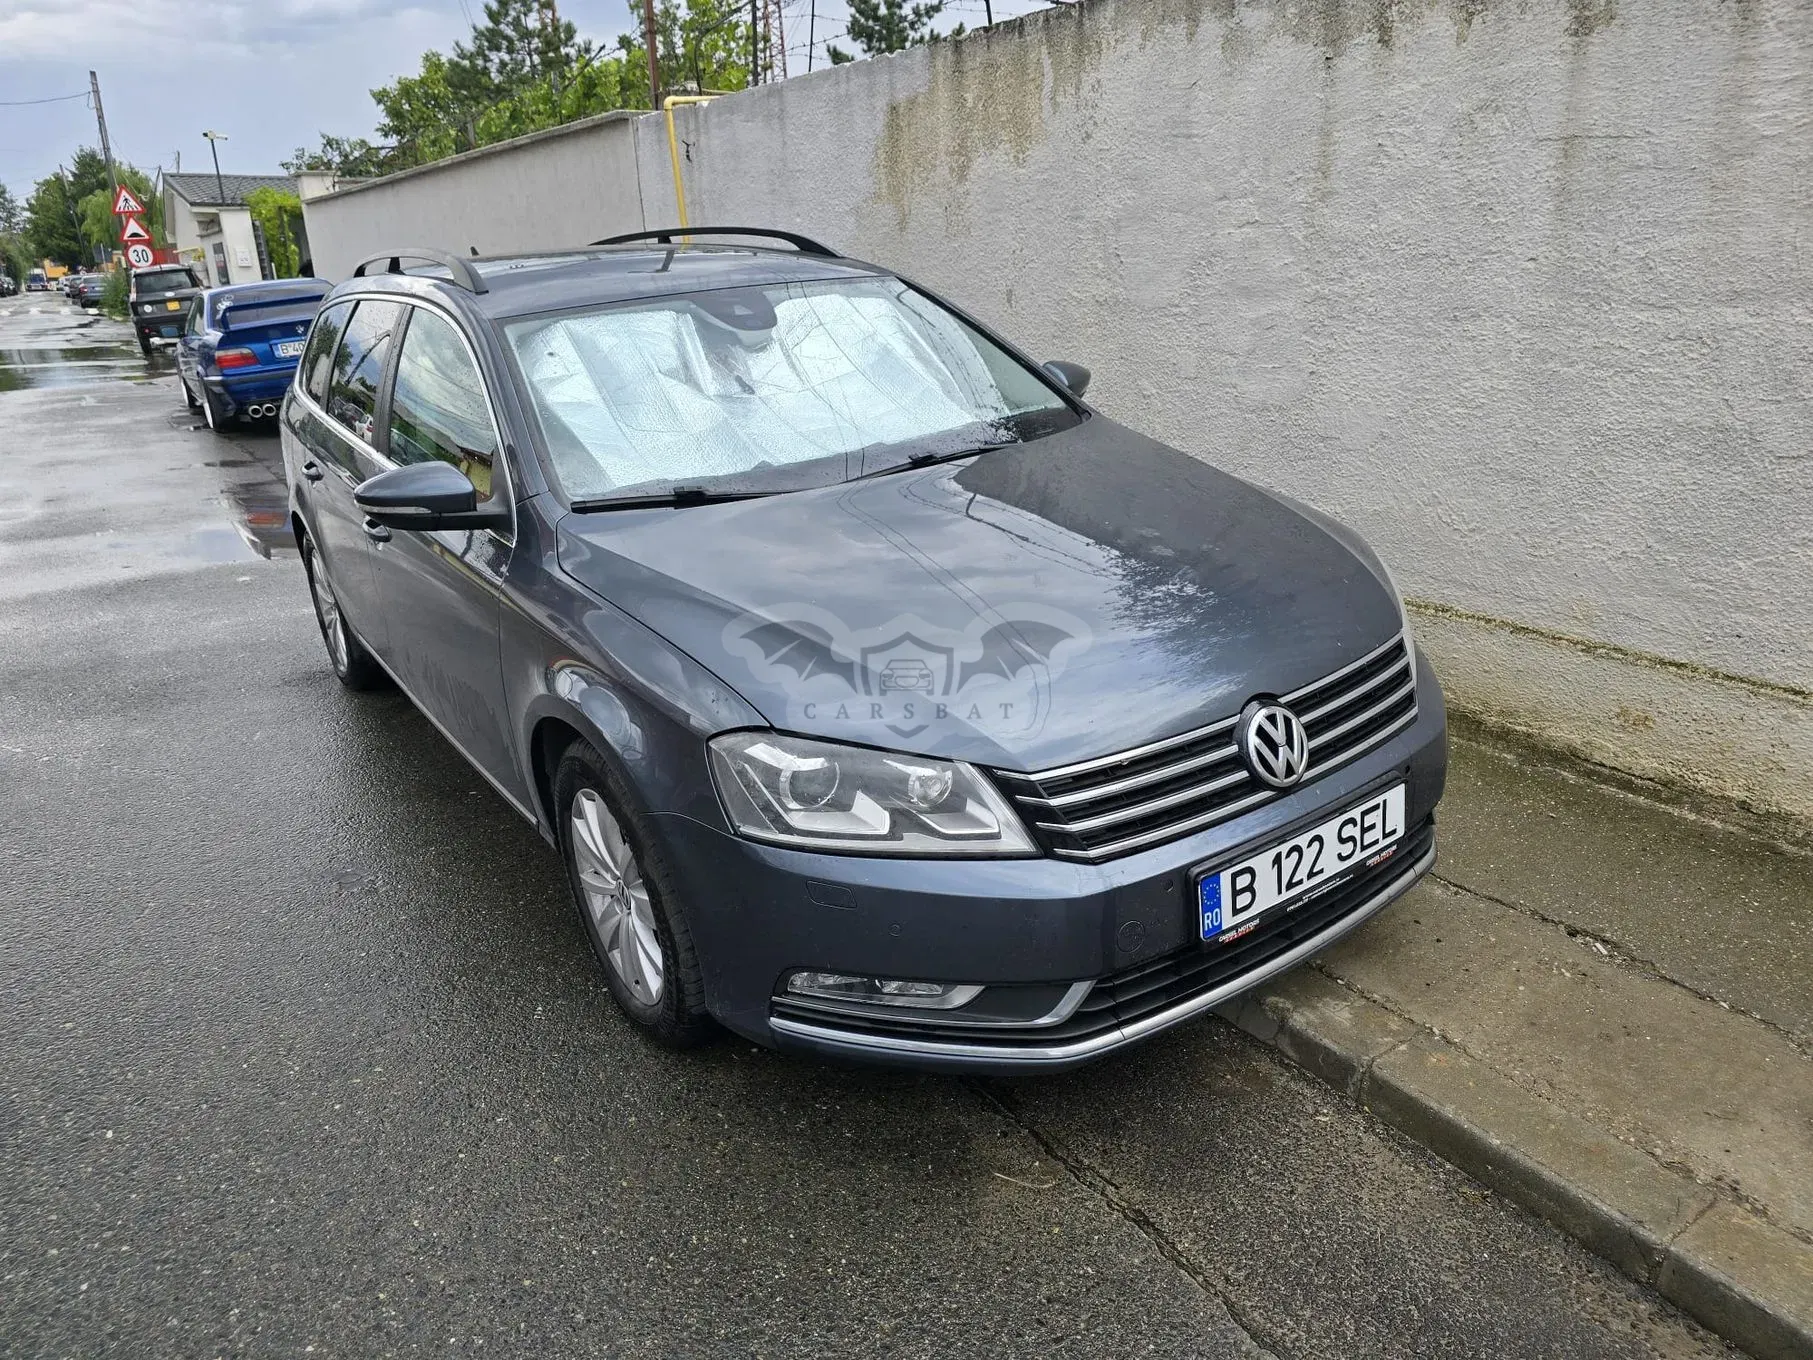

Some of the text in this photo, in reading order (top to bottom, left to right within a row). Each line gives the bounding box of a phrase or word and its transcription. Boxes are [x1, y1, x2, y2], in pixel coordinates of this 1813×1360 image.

[132, 249, 149, 263] 30
[280, 344, 289, 354] B
[1230, 798, 1398, 918] B 122 SEL
[1204, 908, 1221, 931] RO
